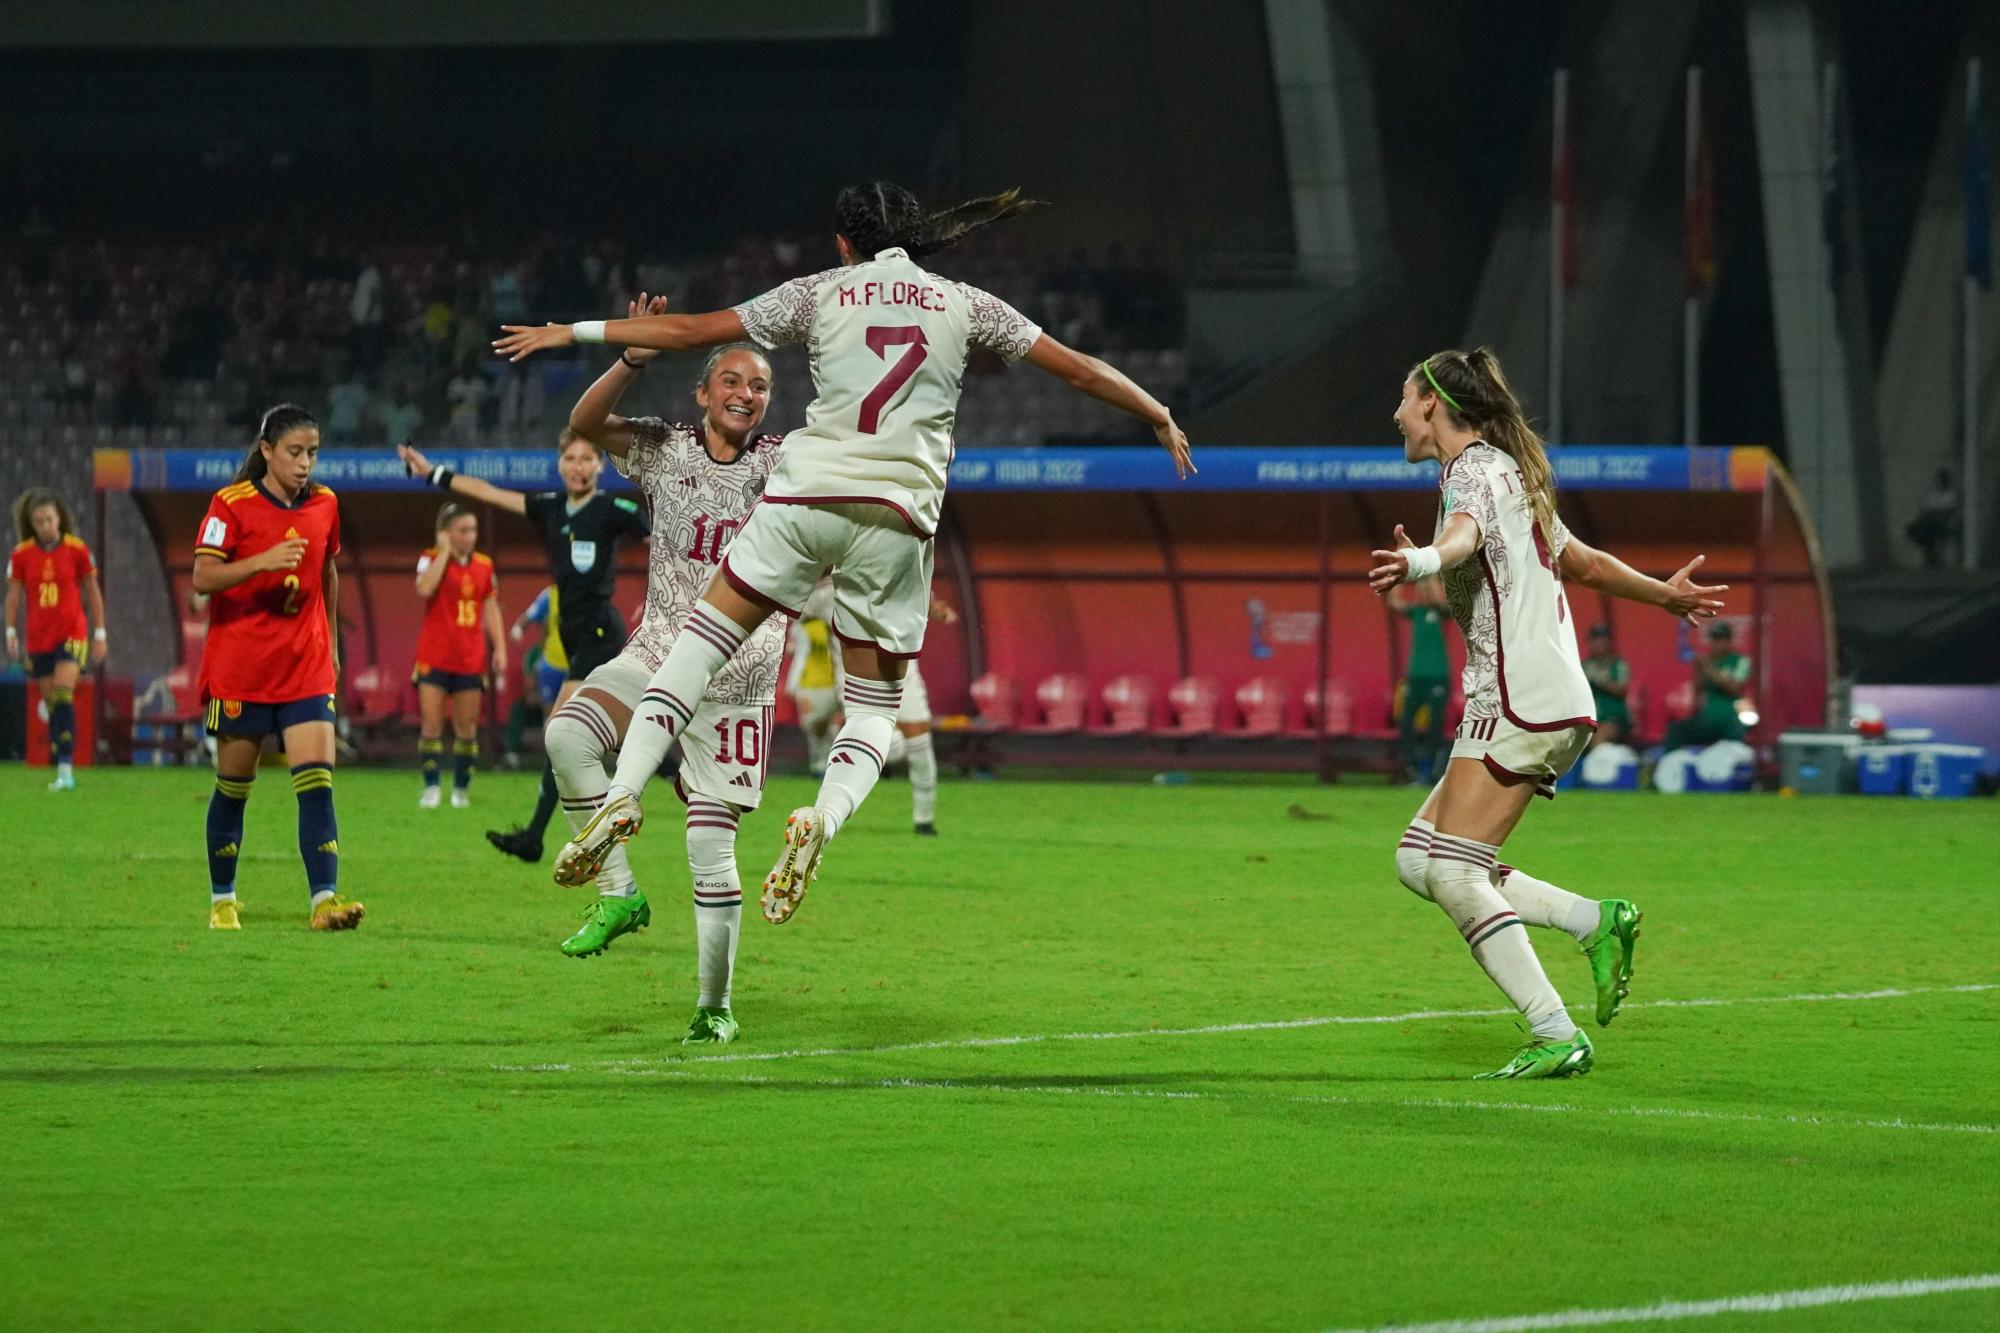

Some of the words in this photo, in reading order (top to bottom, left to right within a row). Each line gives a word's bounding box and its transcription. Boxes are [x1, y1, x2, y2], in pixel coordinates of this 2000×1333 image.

[857, 325, 930, 435] 7
[195, 459, 235, 479] FIFA
[1041, 459, 1085, 483] 2022
[1257, 461, 1298, 480] FIFA
[1601, 456, 1647, 480] 2022
[39, 582, 58, 608] 20
[284, 574, 299, 613] 2
[714, 718, 759, 766] 10
